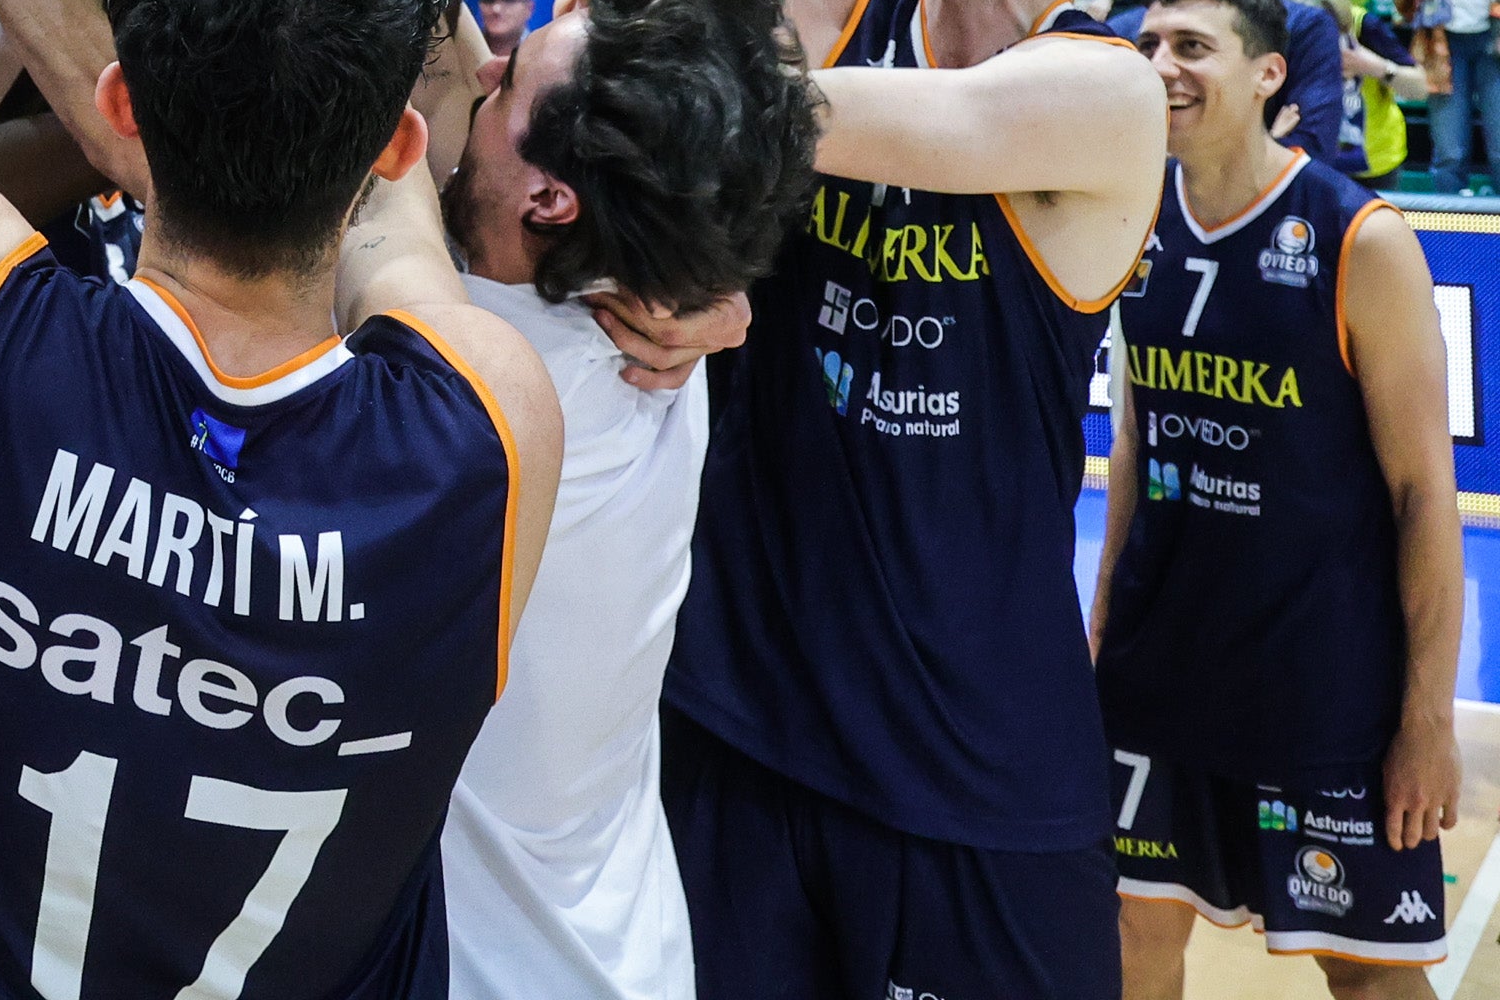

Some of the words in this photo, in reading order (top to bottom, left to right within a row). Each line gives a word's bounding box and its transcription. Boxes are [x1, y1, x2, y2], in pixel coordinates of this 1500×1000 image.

[1182, 257, 1220, 337] 7
[31, 448, 259, 616] MARTÍ
[278, 531, 365, 622] M.
[1114, 749, 1150, 830] 7
[1304, 810, 1374, 835] Asturias
[18, 750, 349, 1000] 17
[1289, 878, 1350, 905] OVIEDO
